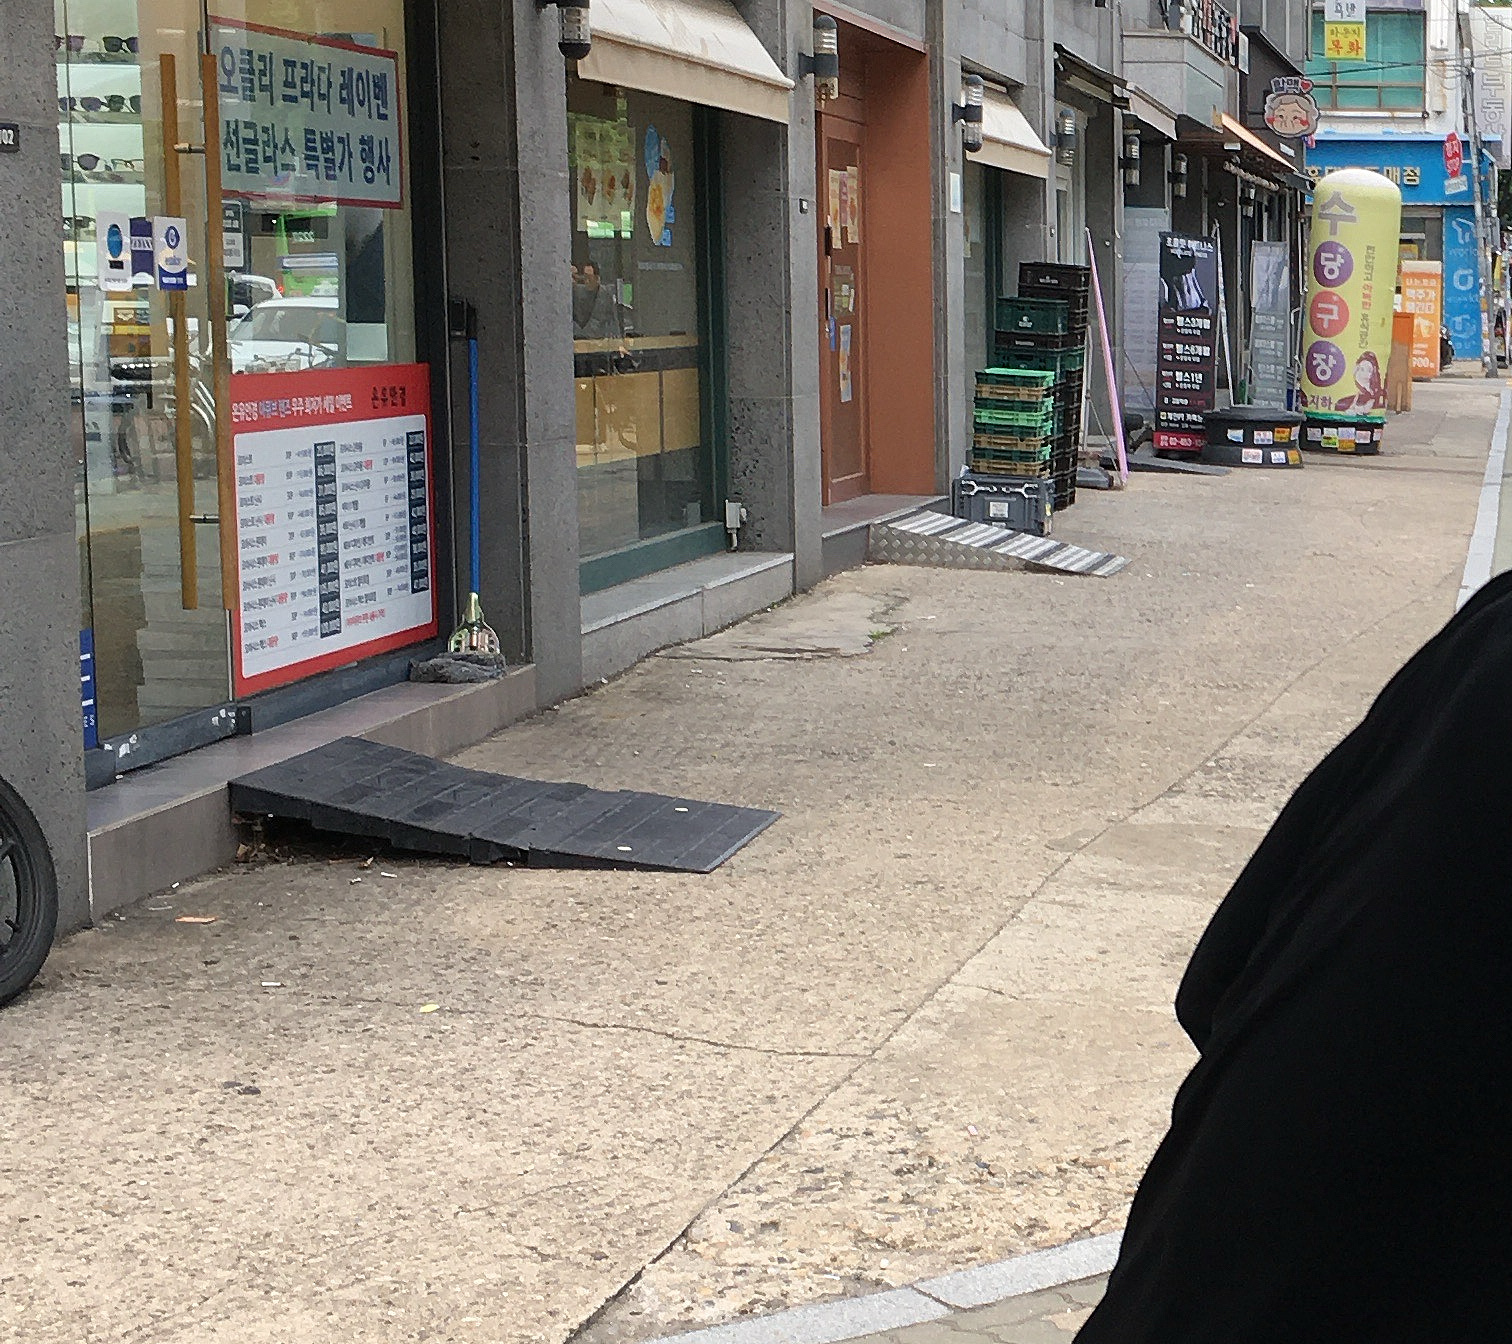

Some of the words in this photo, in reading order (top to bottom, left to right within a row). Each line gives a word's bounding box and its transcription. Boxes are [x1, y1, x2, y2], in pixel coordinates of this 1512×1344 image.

[219, 45, 275, 106] 오클리
[281, 58, 333, 115] 프라다
[338, 66, 389, 122] 레이벤
[222, 118, 297, 177] 선글라스
[303, 127, 354, 183] 특별가
[358, 134, 392, 186] 행사
[1308, 393, 1333, 411] 지하
